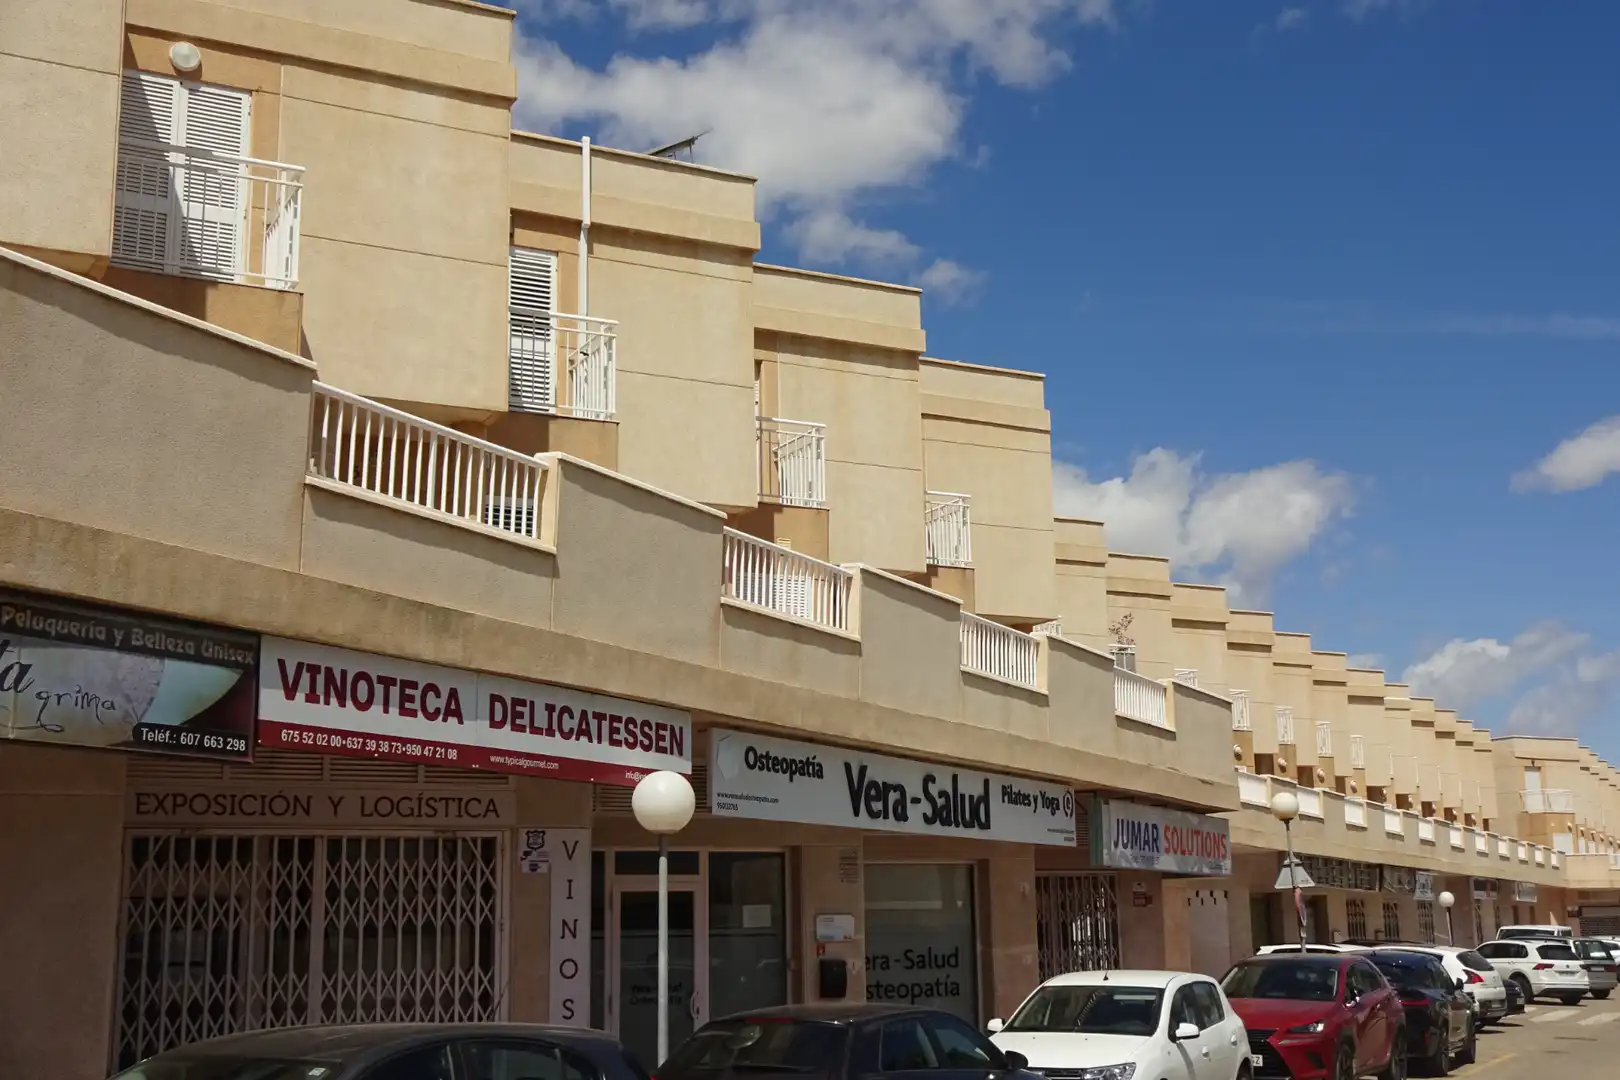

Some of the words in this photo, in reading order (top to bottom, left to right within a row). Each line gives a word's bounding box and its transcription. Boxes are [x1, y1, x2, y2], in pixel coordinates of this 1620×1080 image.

[1, 604, 106, 641] Peluquería
[113, 628, 125, 647] y
[131, 628, 195, 655] Belleza
[201, 637, 254, 665] Unisex
[277, 658, 465, 725] VINOTECA
[489, 693, 684, 757] DELICATESSEN
[140, 727, 177, 744] Teléf.:
[180, 732, 200, 746] 607
[203, 735, 224, 749] 663
[226, 738, 246, 751] 298
[281, 729, 300, 743] 675
[302, 732, 314, 744] 52
[316, 733, 329, 746] 02
[365, 740, 376, 751] 39
[378, 741, 389, 753] 38
[423, 746, 434, 757] 47
[436, 747, 445, 759] 21
[447, 748, 458, 760] 08
[744, 745, 824, 783] Osteopatía
[135, 790, 314, 817] EXPOSICIÓN
[328, 795, 345, 819] Y
[360, 792, 500, 819] LOGÍSTICA
[844, 761, 991, 830] Vera-Salud
[1001, 784, 1031, 807] Pilates
[1033, 794, 1038, 814] y
[1039, 790, 1060, 816] Yoga
[1113, 818, 1160, 853] JUMAR
[1163, 823, 1228, 861] SOLUTIONS
[559, 840, 580, 1020] VINOS
[866, 974, 960, 1005] steopatía
